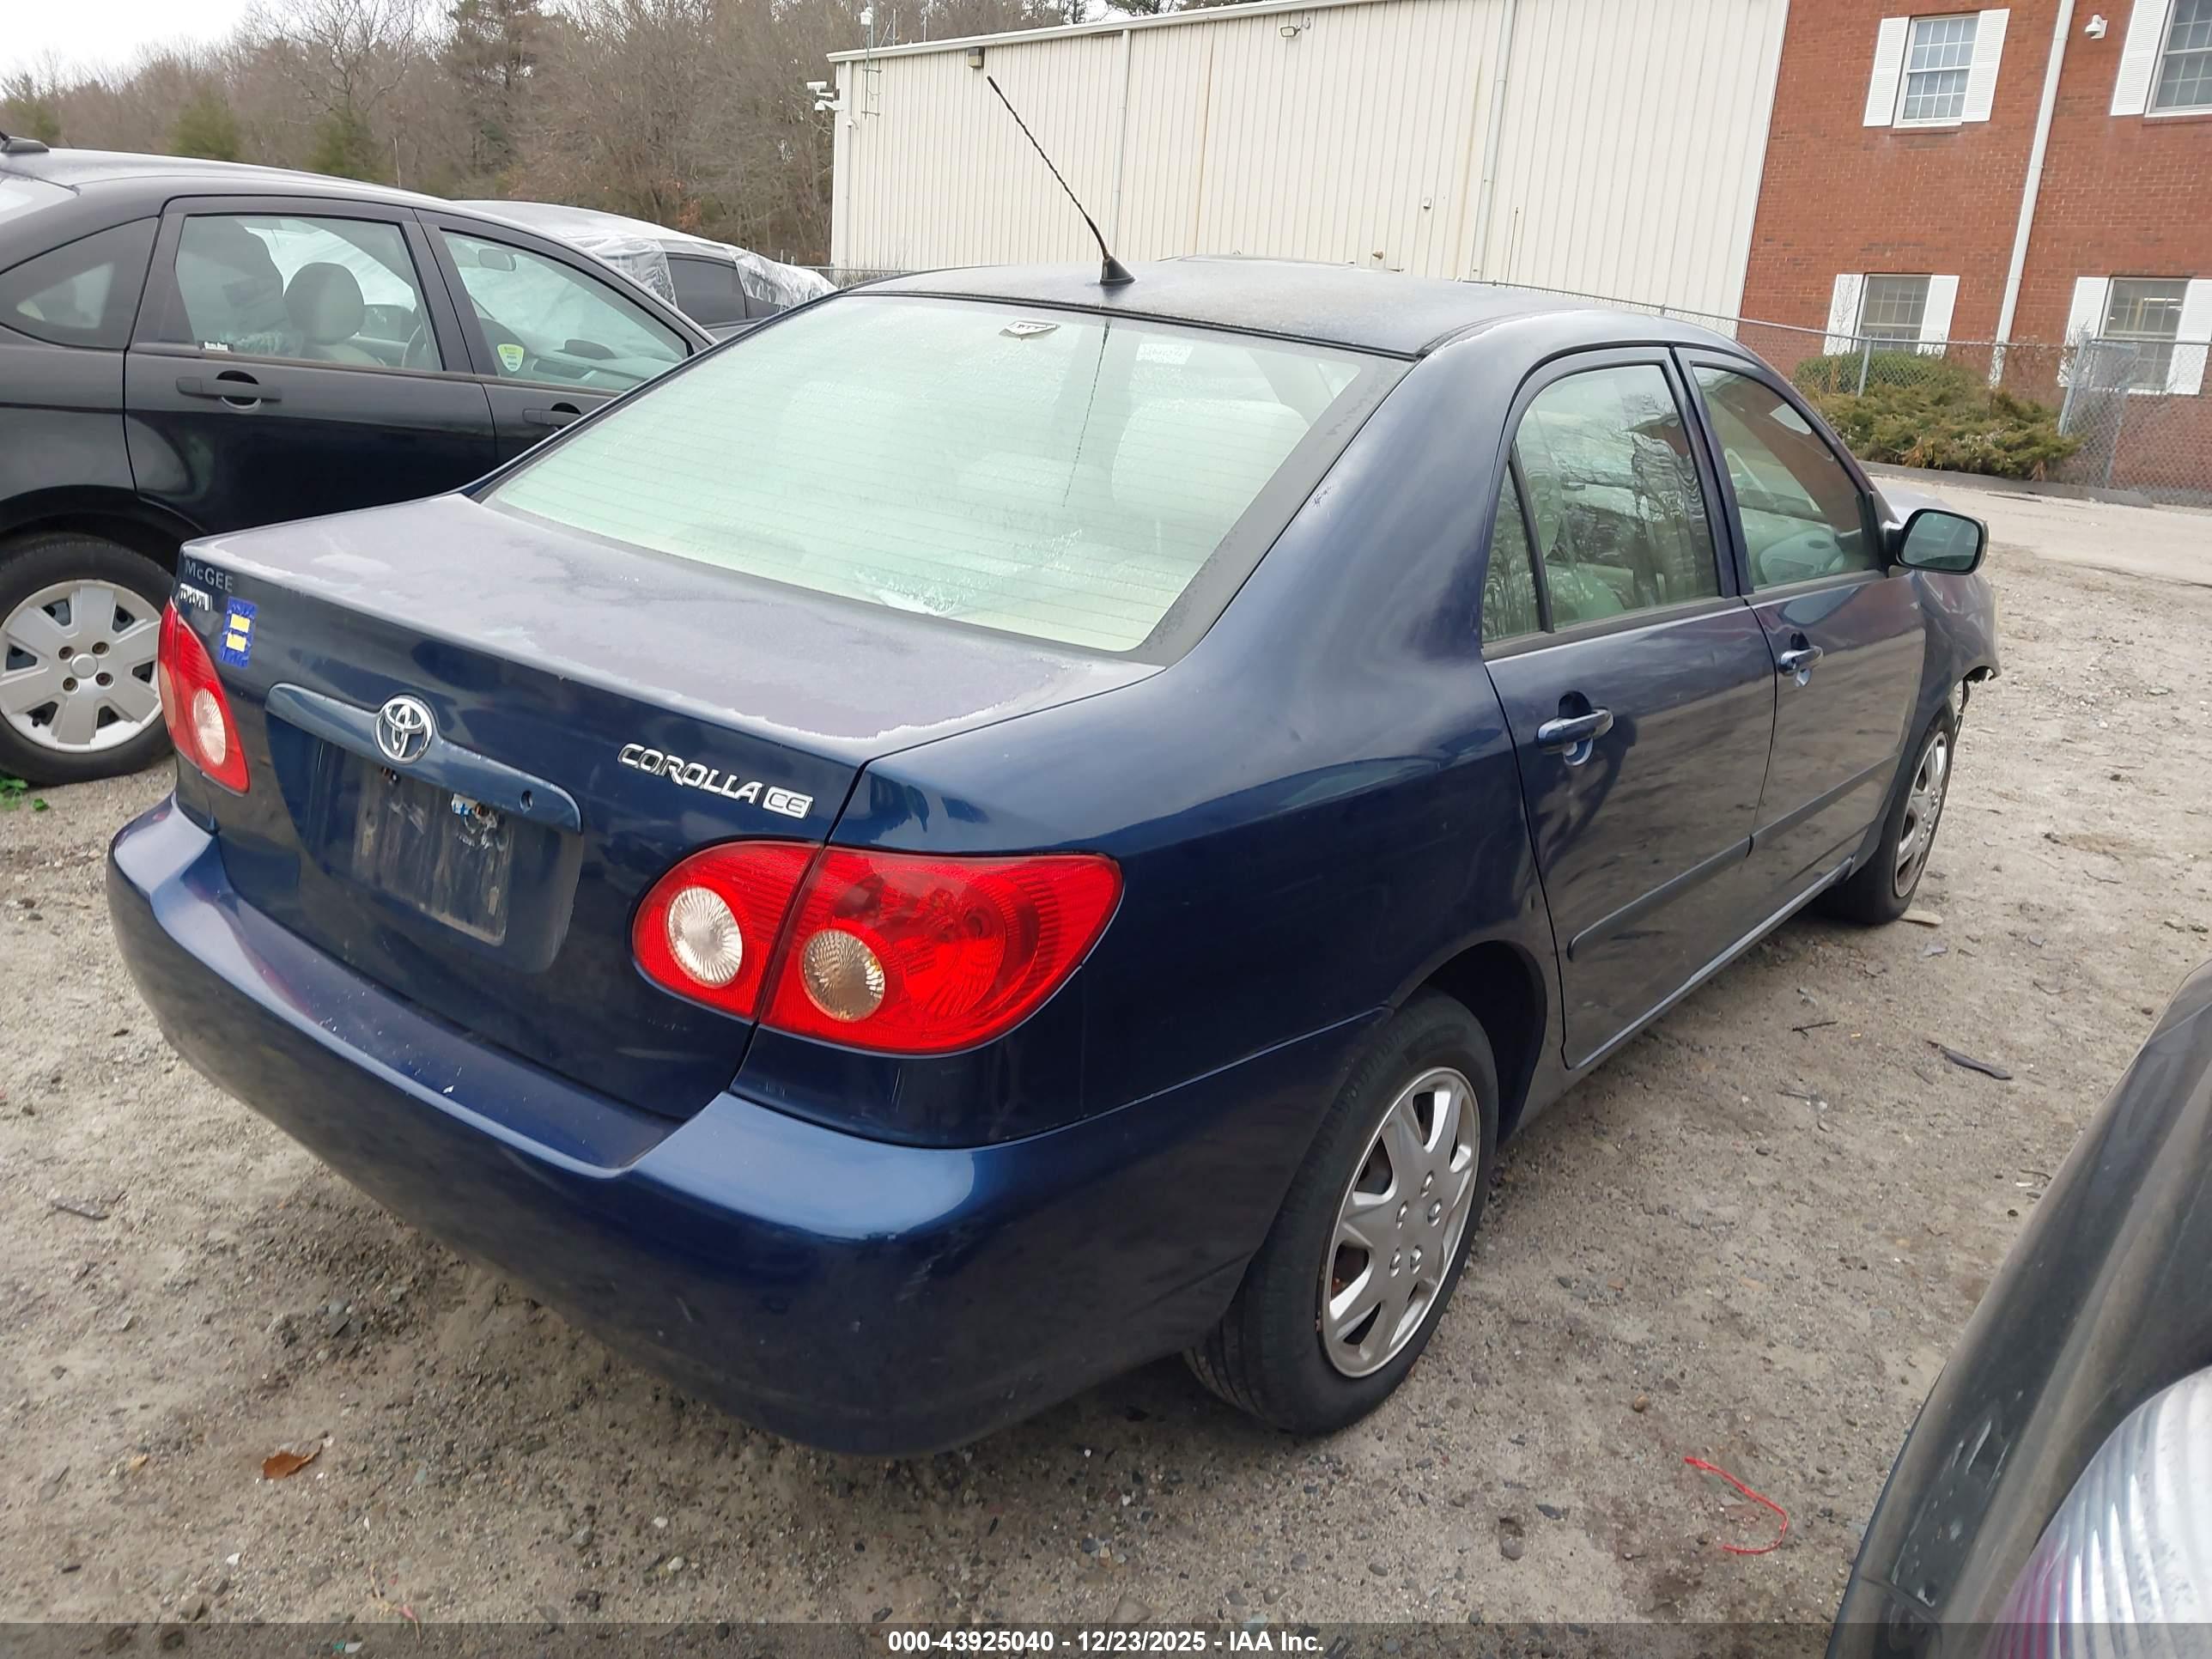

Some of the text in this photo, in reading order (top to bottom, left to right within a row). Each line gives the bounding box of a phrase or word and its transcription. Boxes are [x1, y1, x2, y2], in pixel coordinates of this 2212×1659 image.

[185, 559, 234, 592] McGEE
[617, 743, 811, 816] COROLLA CE
